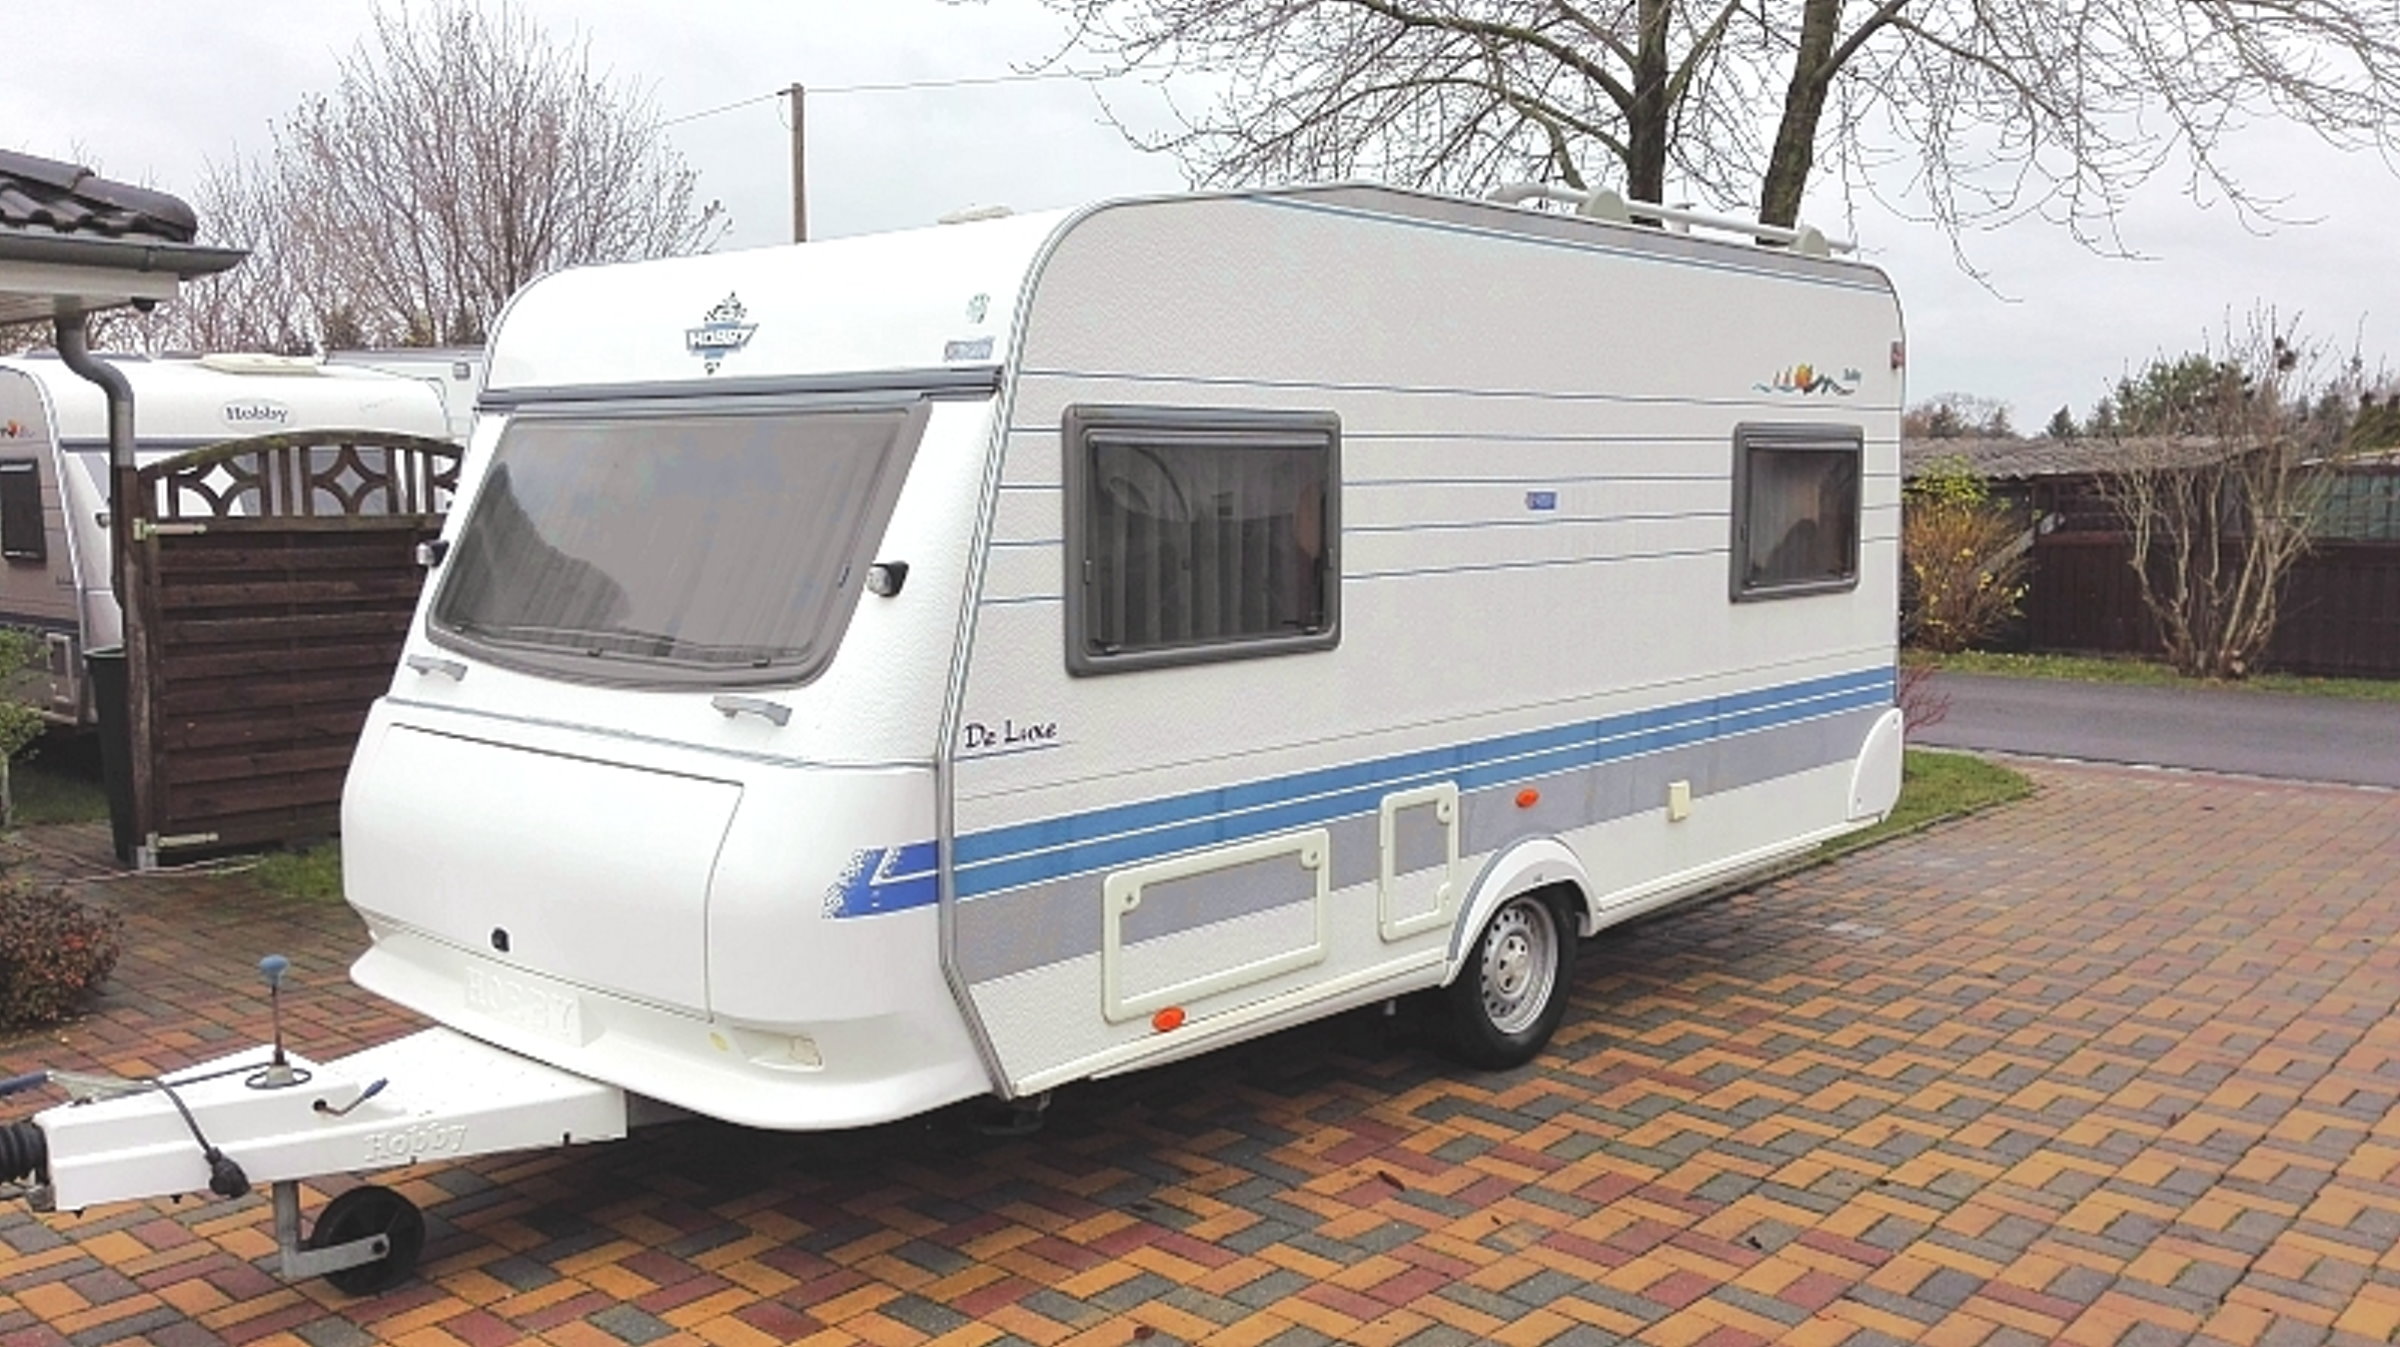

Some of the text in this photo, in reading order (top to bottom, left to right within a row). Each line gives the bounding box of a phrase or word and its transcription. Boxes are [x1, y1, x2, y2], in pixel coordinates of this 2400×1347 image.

[687, 326, 757, 348] HOBBY
[226, 405, 288, 424] Hobby
[965, 723, 996, 748] De
[364, 1122, 468, 1163] Hobby
